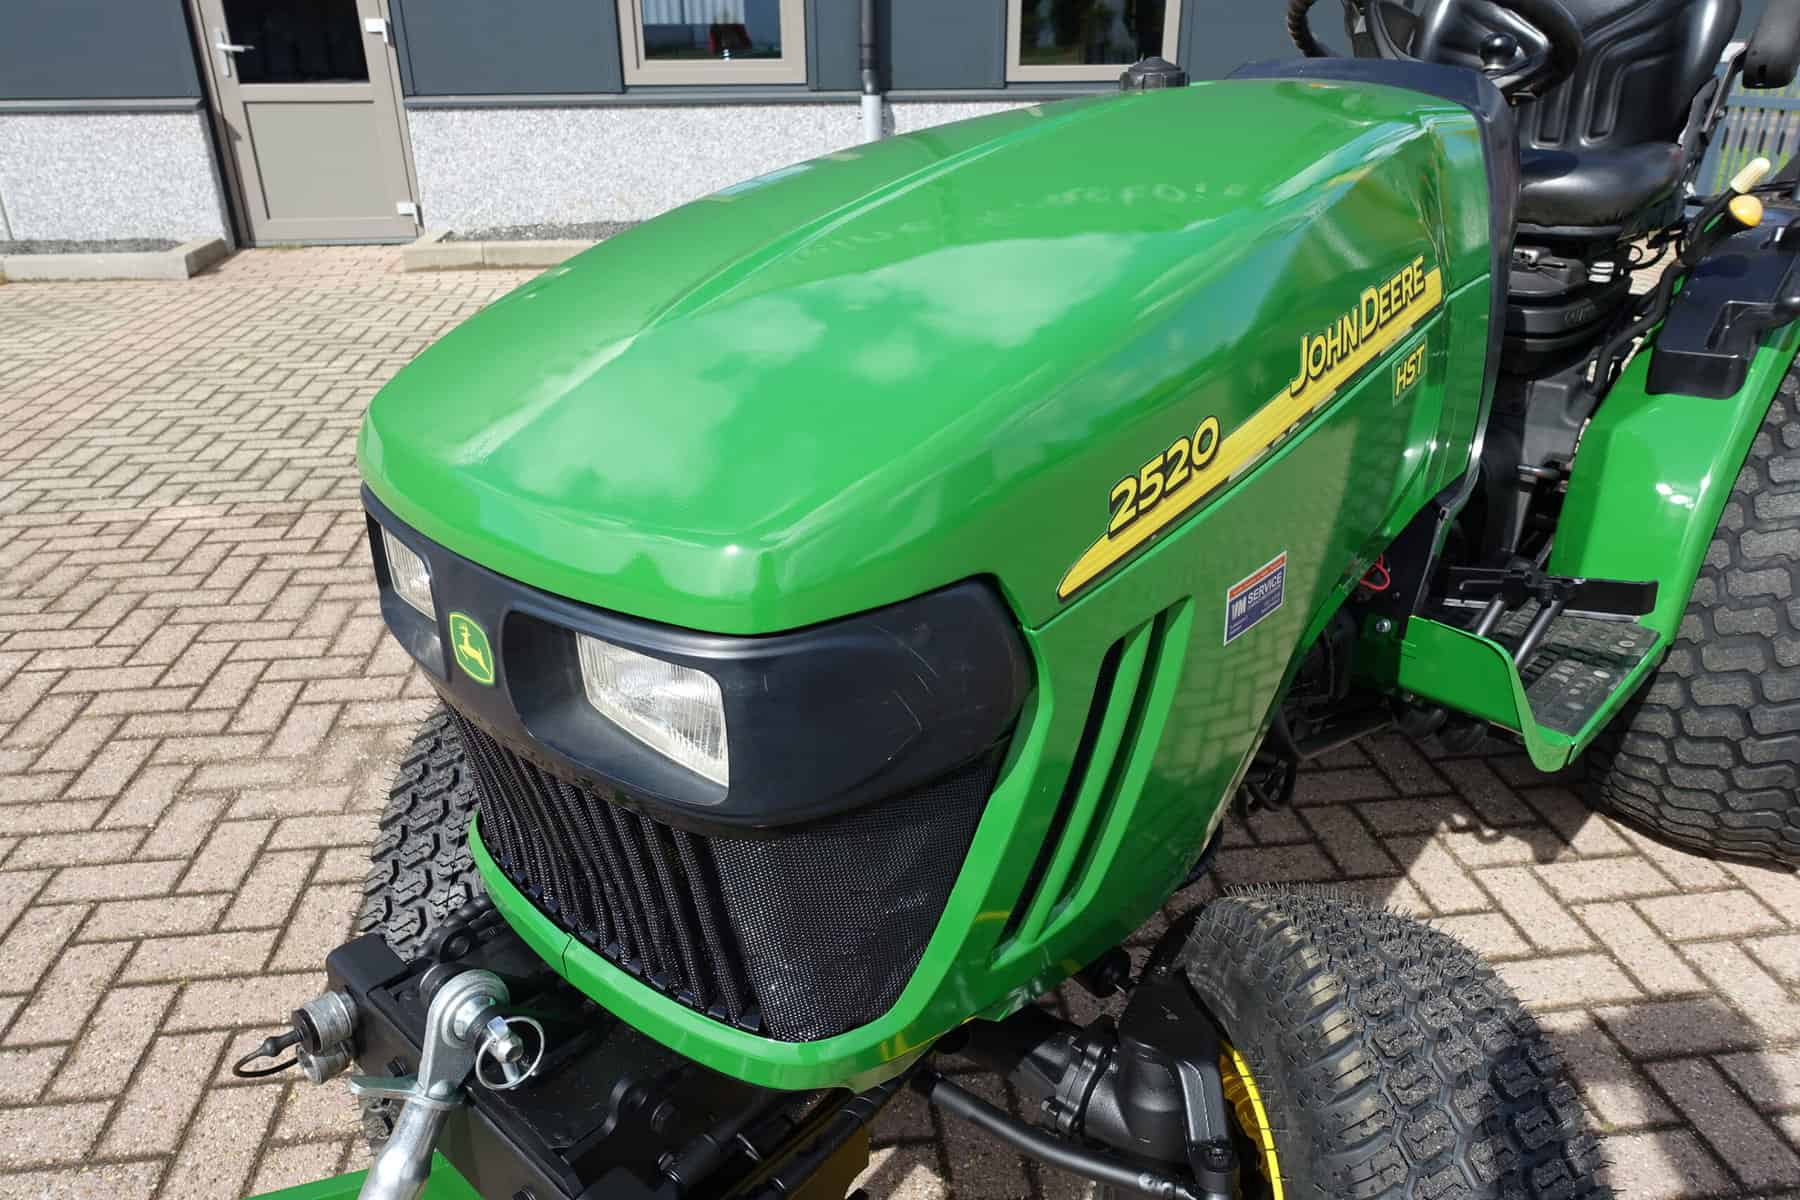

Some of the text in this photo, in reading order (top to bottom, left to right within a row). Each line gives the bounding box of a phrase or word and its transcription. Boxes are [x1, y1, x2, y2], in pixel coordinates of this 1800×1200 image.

[1290, 255, 1425, 396] JOHN DEERE
[1395, 344, 1425, 396] HST
[1107, 415, 1220, 539] 2520
[1247, 571, 1283, 604] SERVICE
